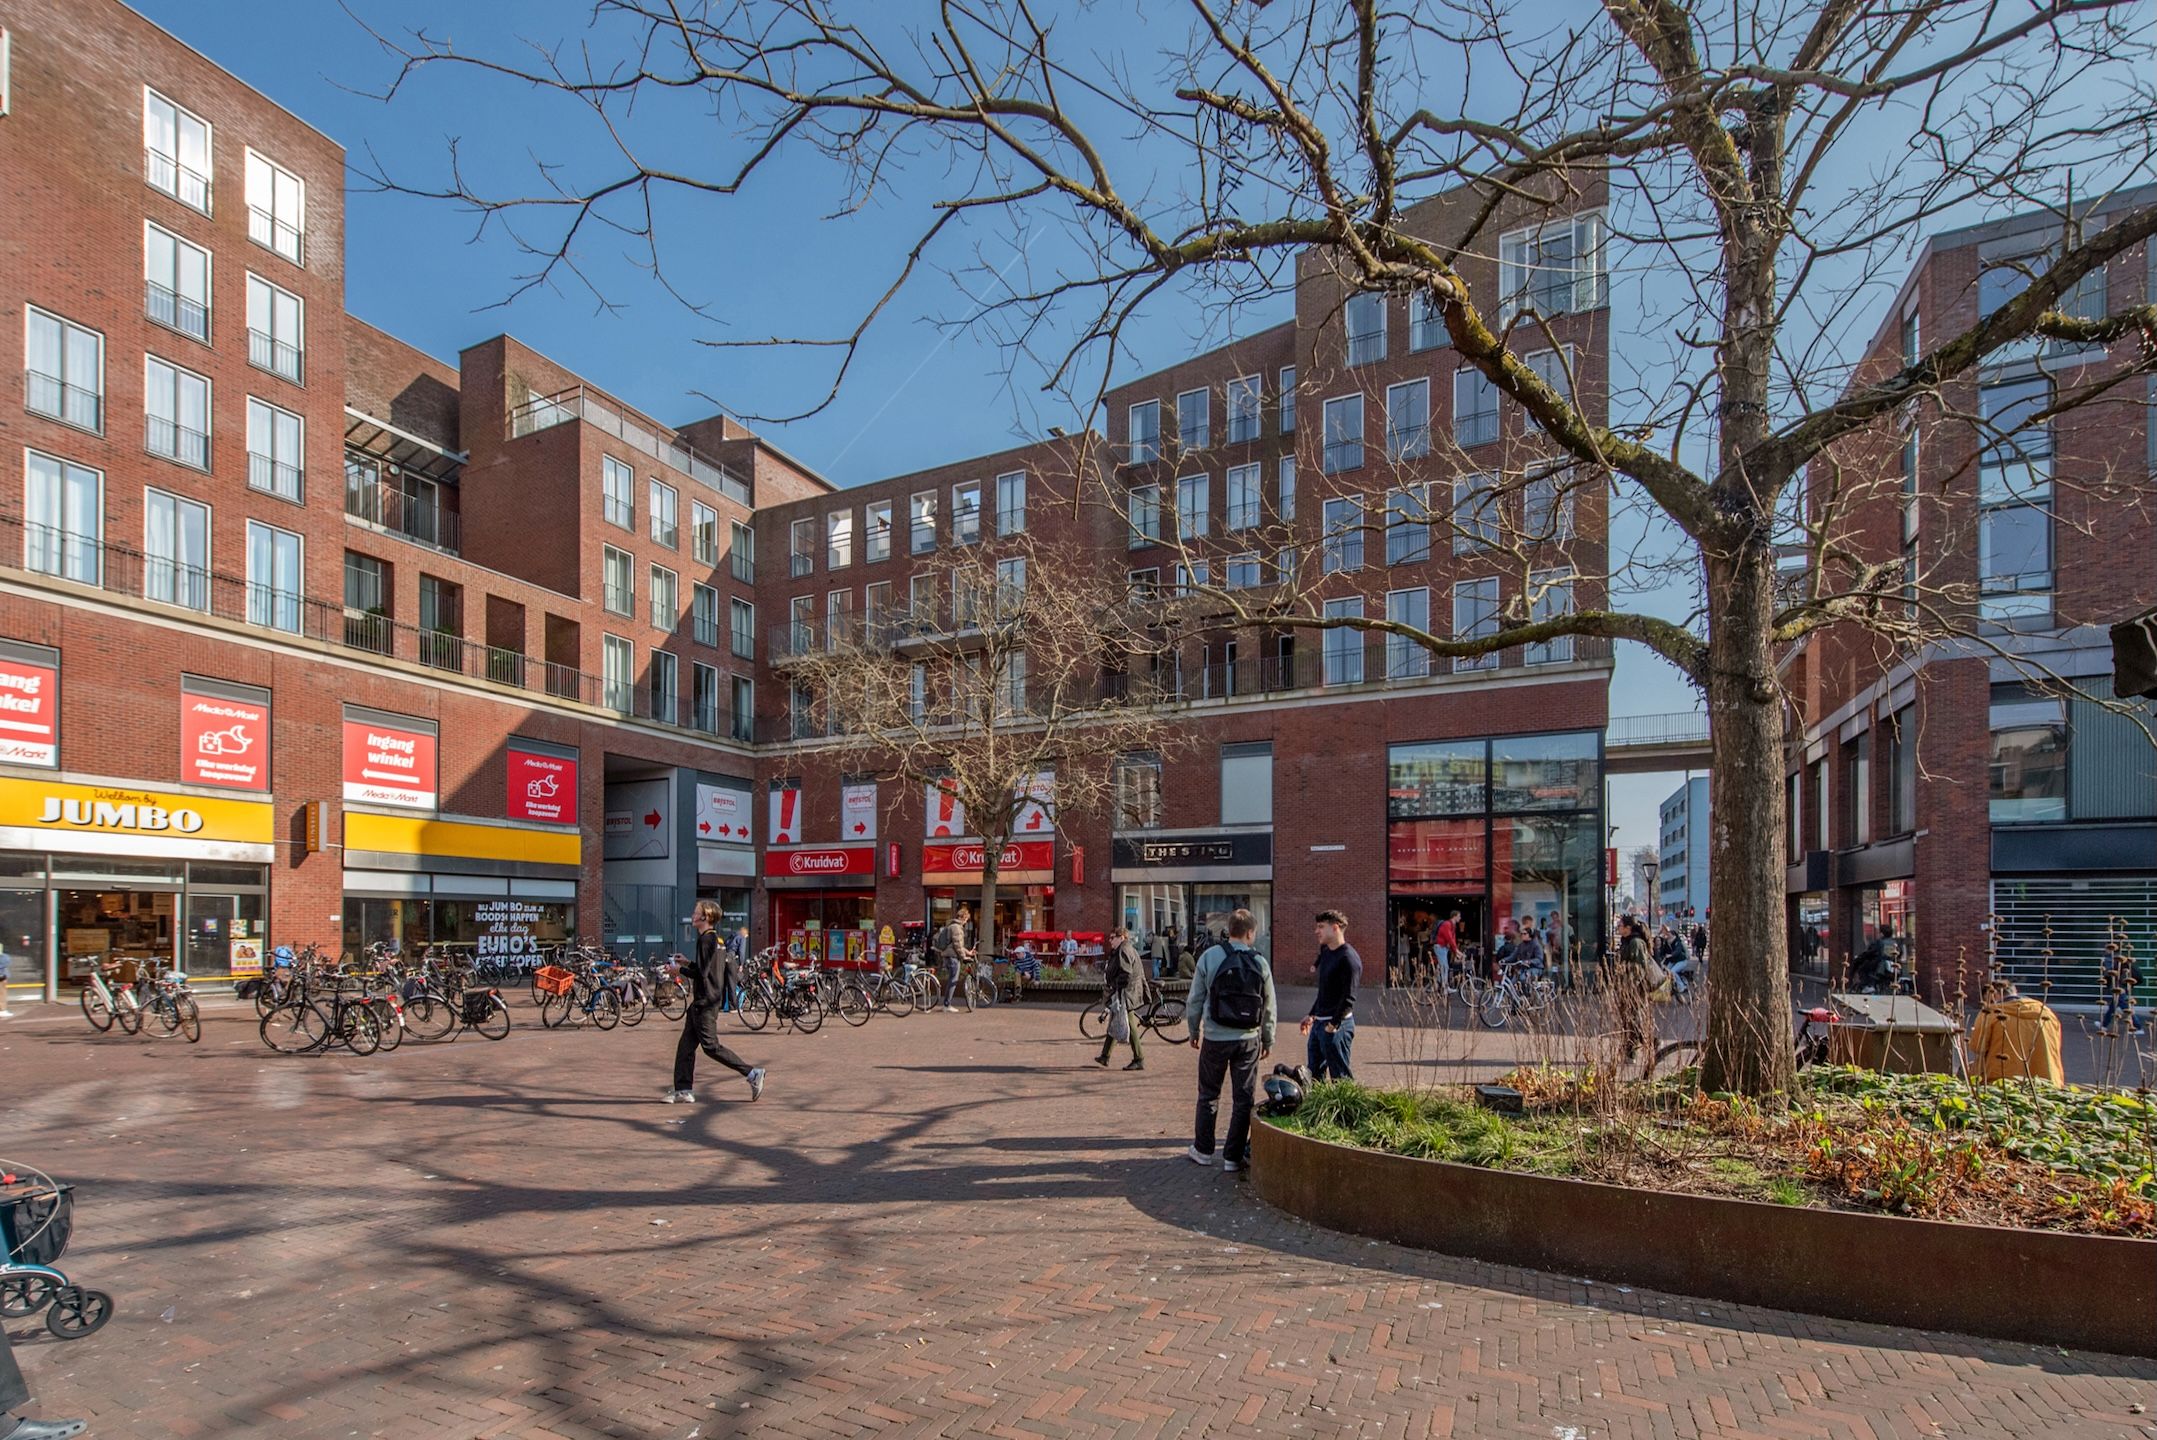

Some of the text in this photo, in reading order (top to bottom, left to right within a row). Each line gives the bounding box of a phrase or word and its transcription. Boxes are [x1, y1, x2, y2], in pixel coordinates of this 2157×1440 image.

[0, 693, 41, 714] kel
[367, 733, 415, 754] Ingang
[368, 752, 415, 768] winkel
[94, 788, 142, 803] Welkom
[711, 797, 736, 807] BRISTOL
[37, 796, 204, 833] JUMBO
[606, 817, 632, 828] BRISTOL
[969, 850, 1017, 864] Krvat
[1147, 847, 1176, 857] THE
[804, 855, 844, 868] Kruidvat
[478, 903, 489, 911] BIJ
[489, 901, 523, 912] JUMBO
[489, 922, 529, 936] elke dag
[478, 935, 538, 954] EURO'S
